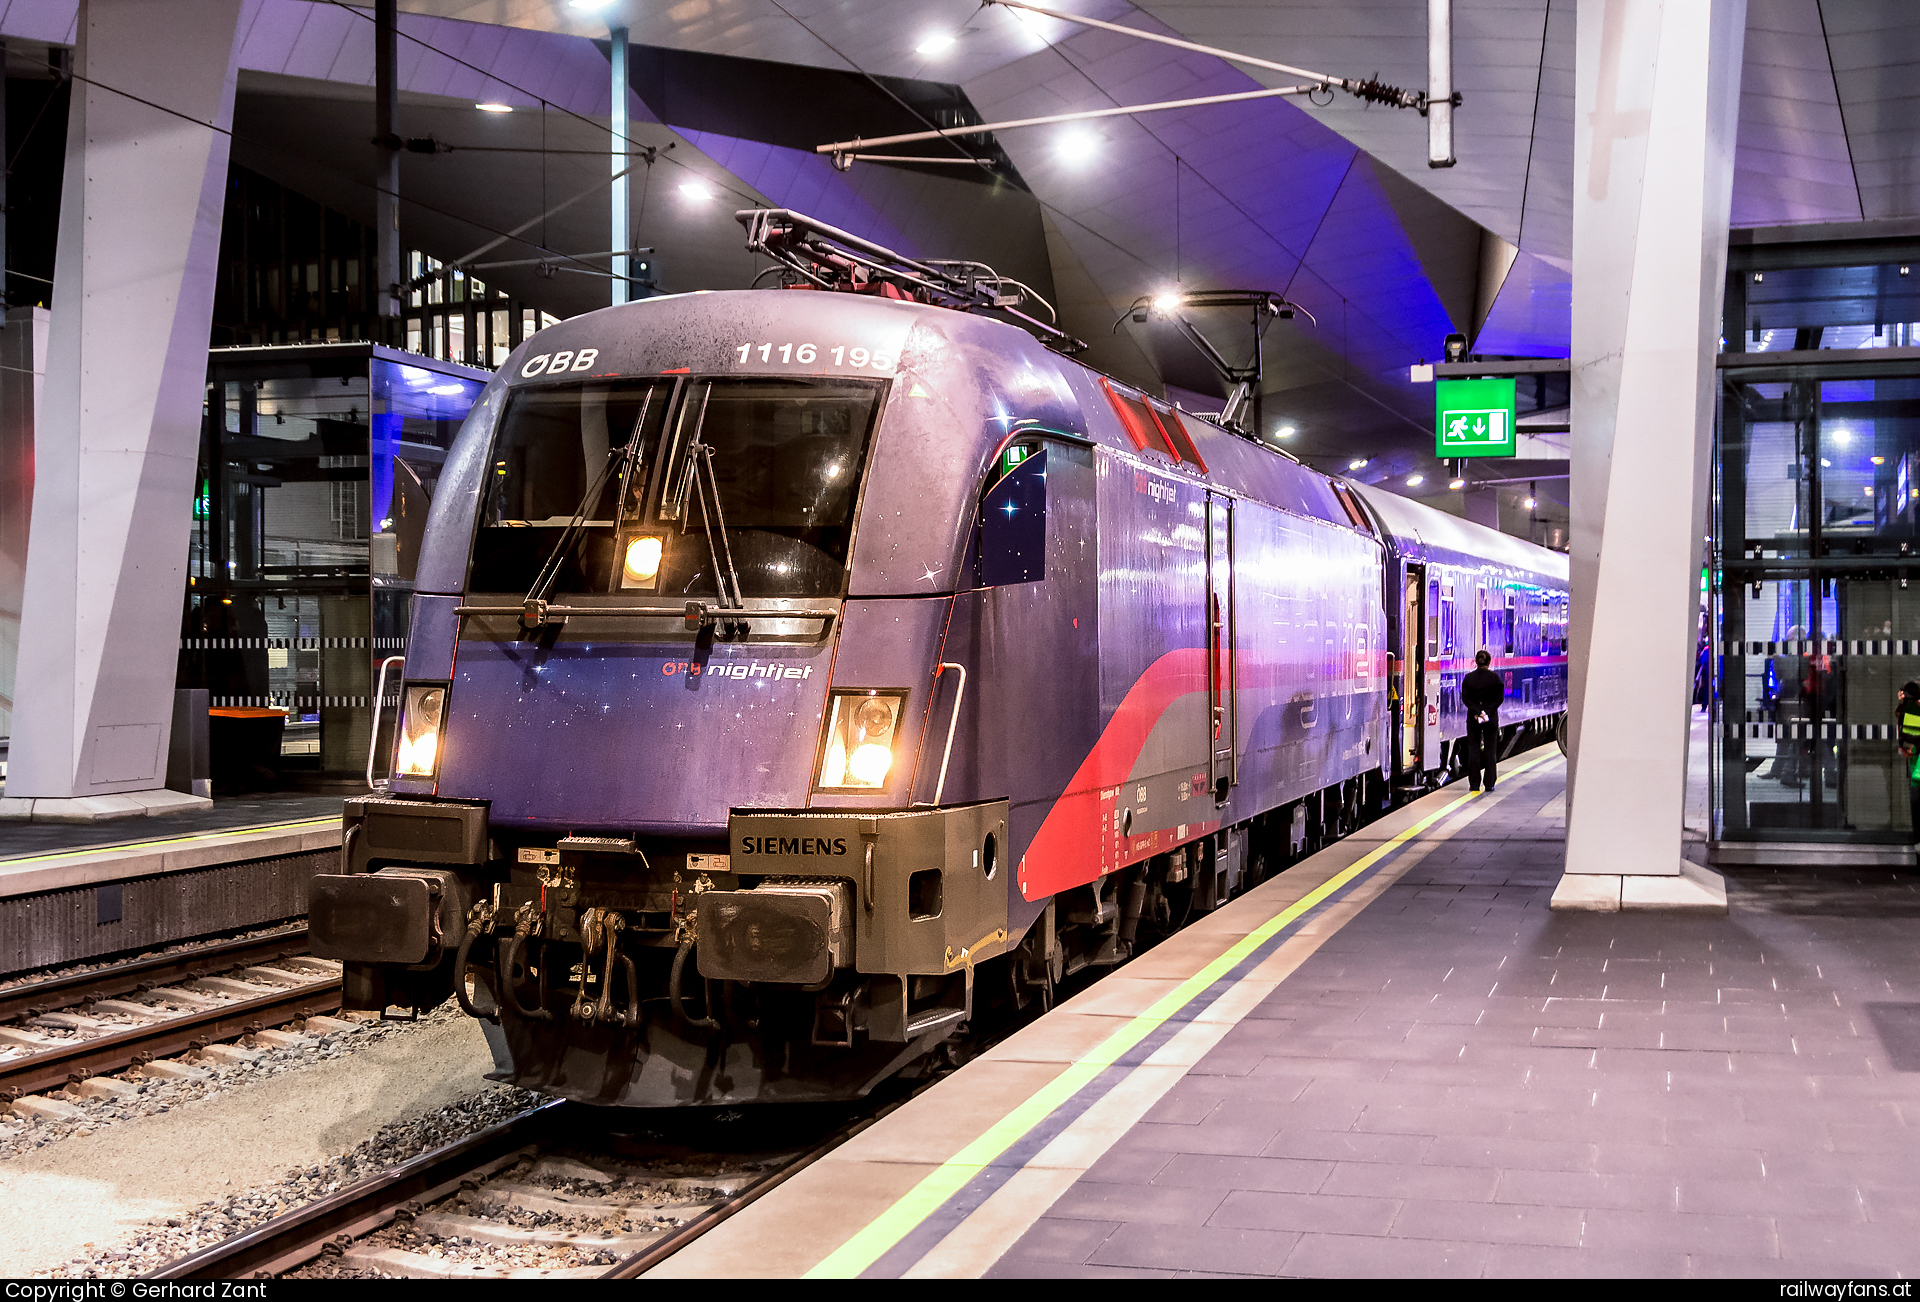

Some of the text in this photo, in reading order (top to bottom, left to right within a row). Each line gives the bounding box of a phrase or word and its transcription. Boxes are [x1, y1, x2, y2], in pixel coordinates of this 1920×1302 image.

[736, 342, 896, 371] 1116 195
[707, 662, 814, 681] nightjet
[741, 836, 847, 856] SIEMENS
